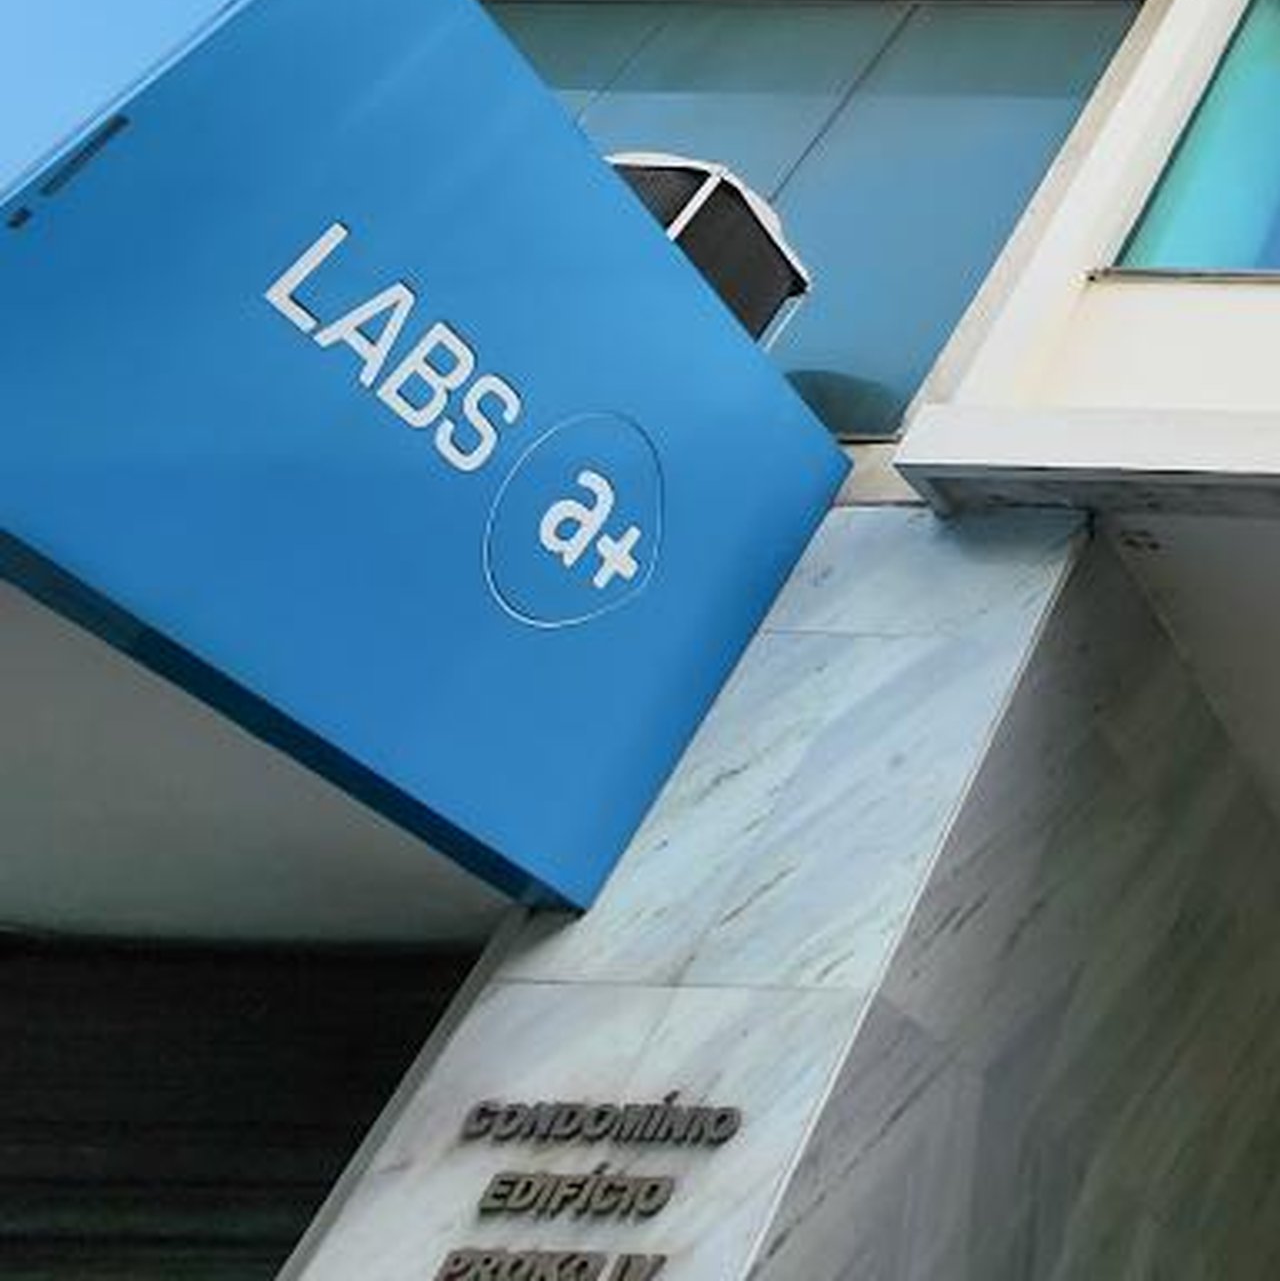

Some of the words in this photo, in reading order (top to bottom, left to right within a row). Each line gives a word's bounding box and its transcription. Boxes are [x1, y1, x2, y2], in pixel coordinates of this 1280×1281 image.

[264, 222, 522, 472] LABS
[538, 469, 642, 589] a+
[460, 1090, 742, 1147] CONDOMÍNIO
[477, 1162, 676, 1221] EDIFÍCIO
